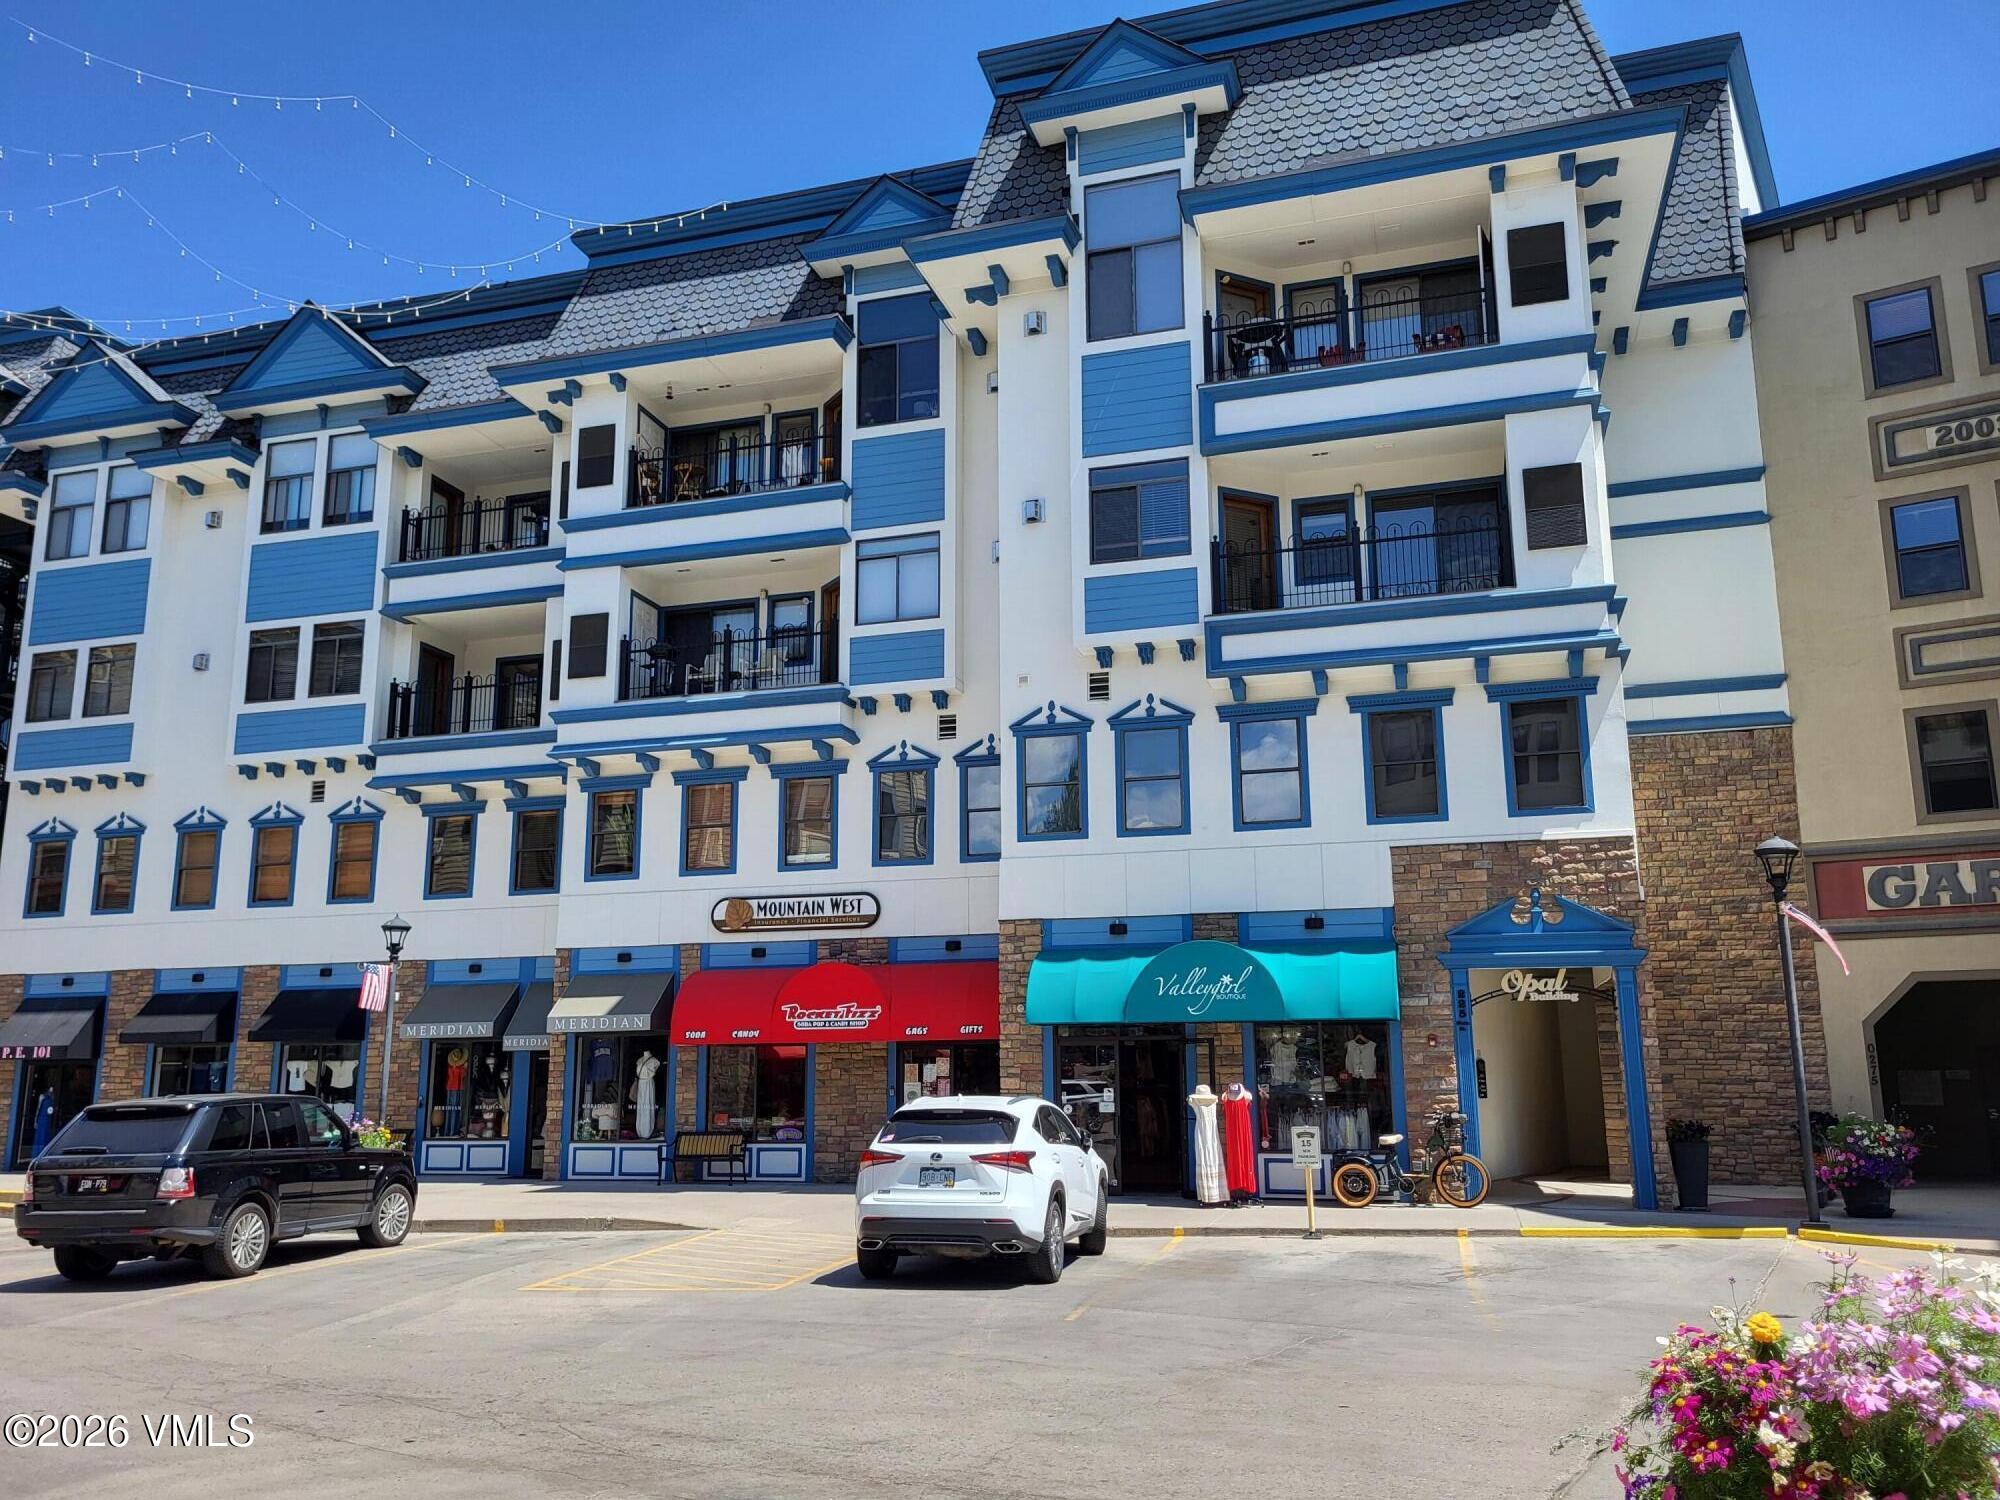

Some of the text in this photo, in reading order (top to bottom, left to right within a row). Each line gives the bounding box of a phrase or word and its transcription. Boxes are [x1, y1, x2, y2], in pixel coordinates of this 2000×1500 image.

[1935, 416, 2000, 447] 200
[757, 897, 863, 917] MOUNTAIN WEST
[1153, 966, 1253, 1015] Valleygirl
[1501, 968, 1568, 1001] Opal
[1528, 991, 1579, 1002] Building
[783, 1003, 880, 1020] ROCKET FIZZ
[555, 1016, 643, 1029] MERIDIAN
[406, 1024, 487, 1036] MERIDIAN
[685, 1031, 706, 1039] SODA
[732, 1030, 760, 1038] CANDY
[905, 1027, 928, 1035] GAGS
[960, 1025, 983, 1034] GIFTS
[504, 1038, 550, 1047] MERIDIA
[33, 1046, 51, 1058] 101
[1867, 1043, 1878, 1085] 0275
